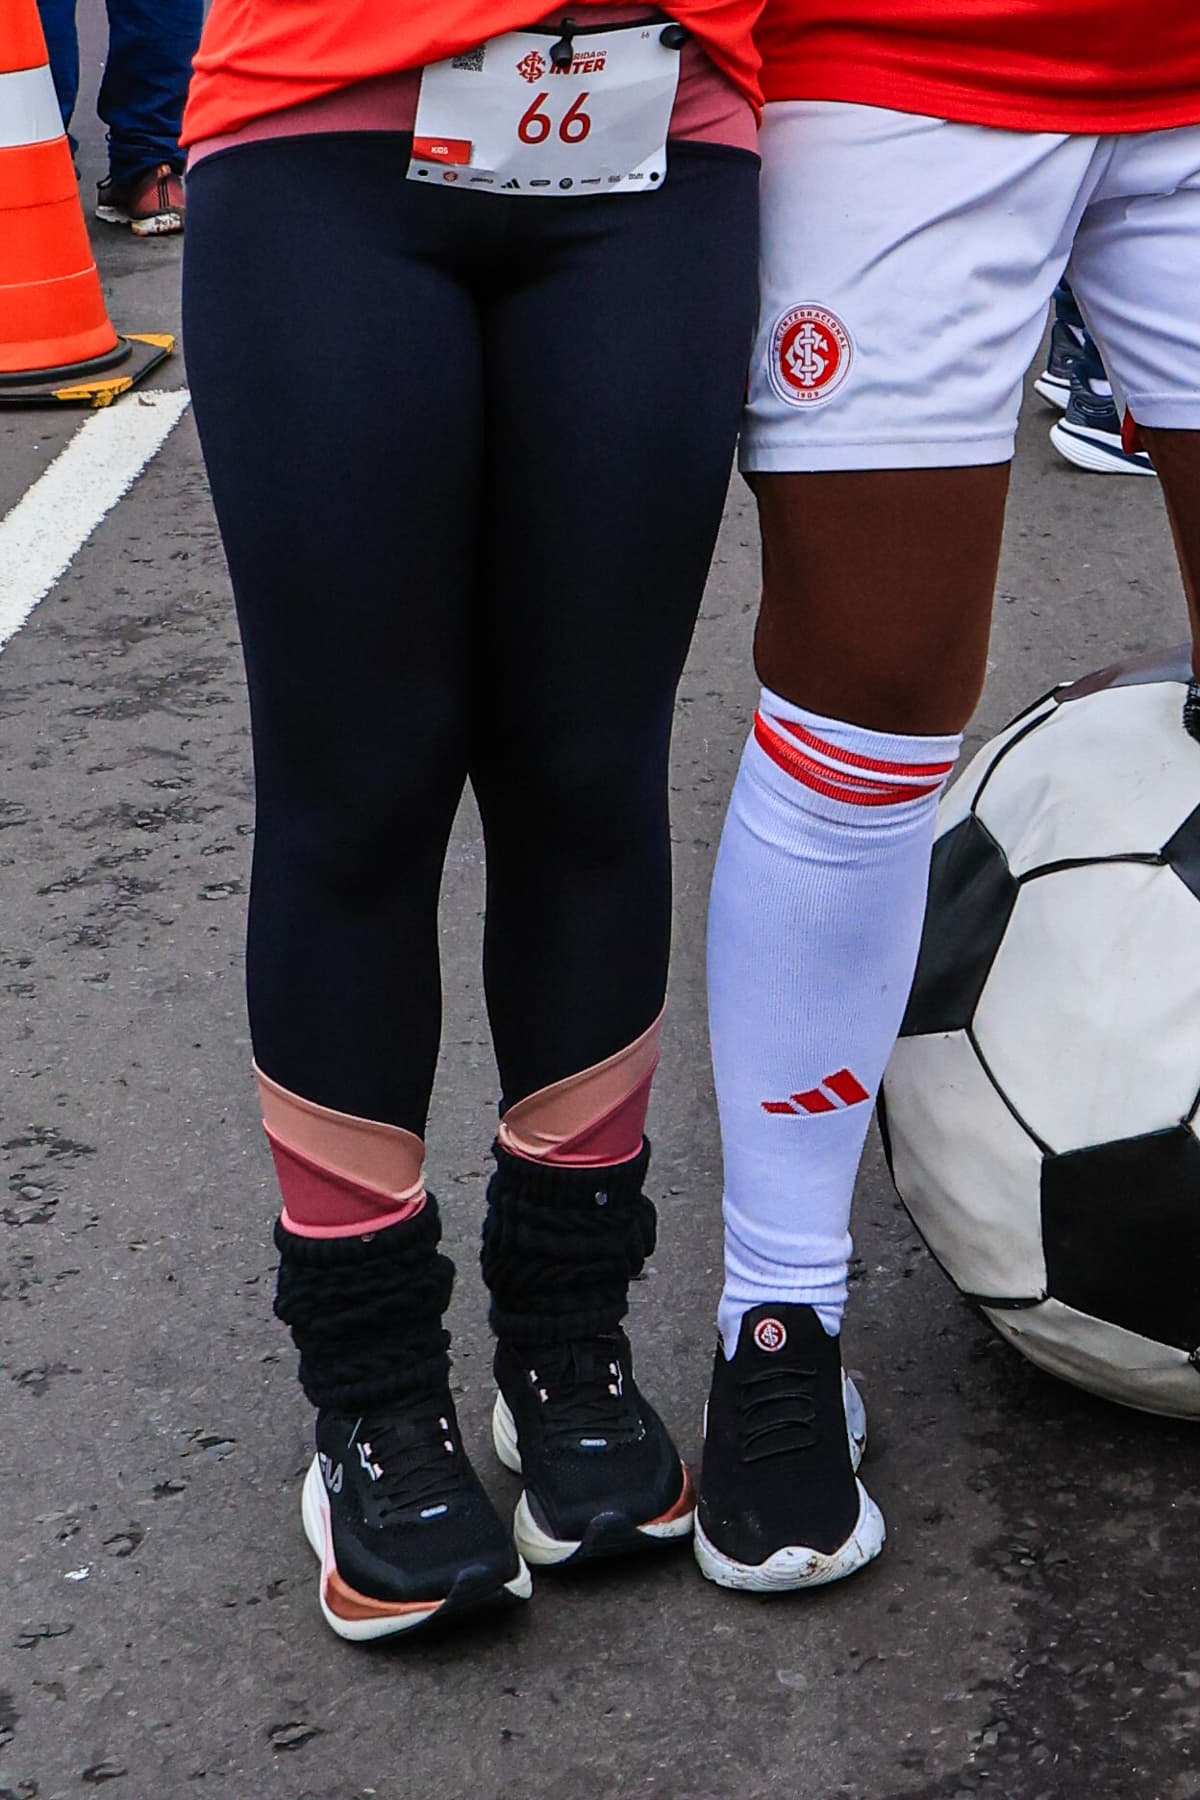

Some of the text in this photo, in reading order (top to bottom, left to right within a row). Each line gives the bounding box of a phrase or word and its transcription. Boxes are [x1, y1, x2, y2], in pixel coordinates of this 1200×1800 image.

[572, 50, 596, 60] RIDA
[549, 58, 606, 75] INTER
[517, 92, 592, 145] 66
